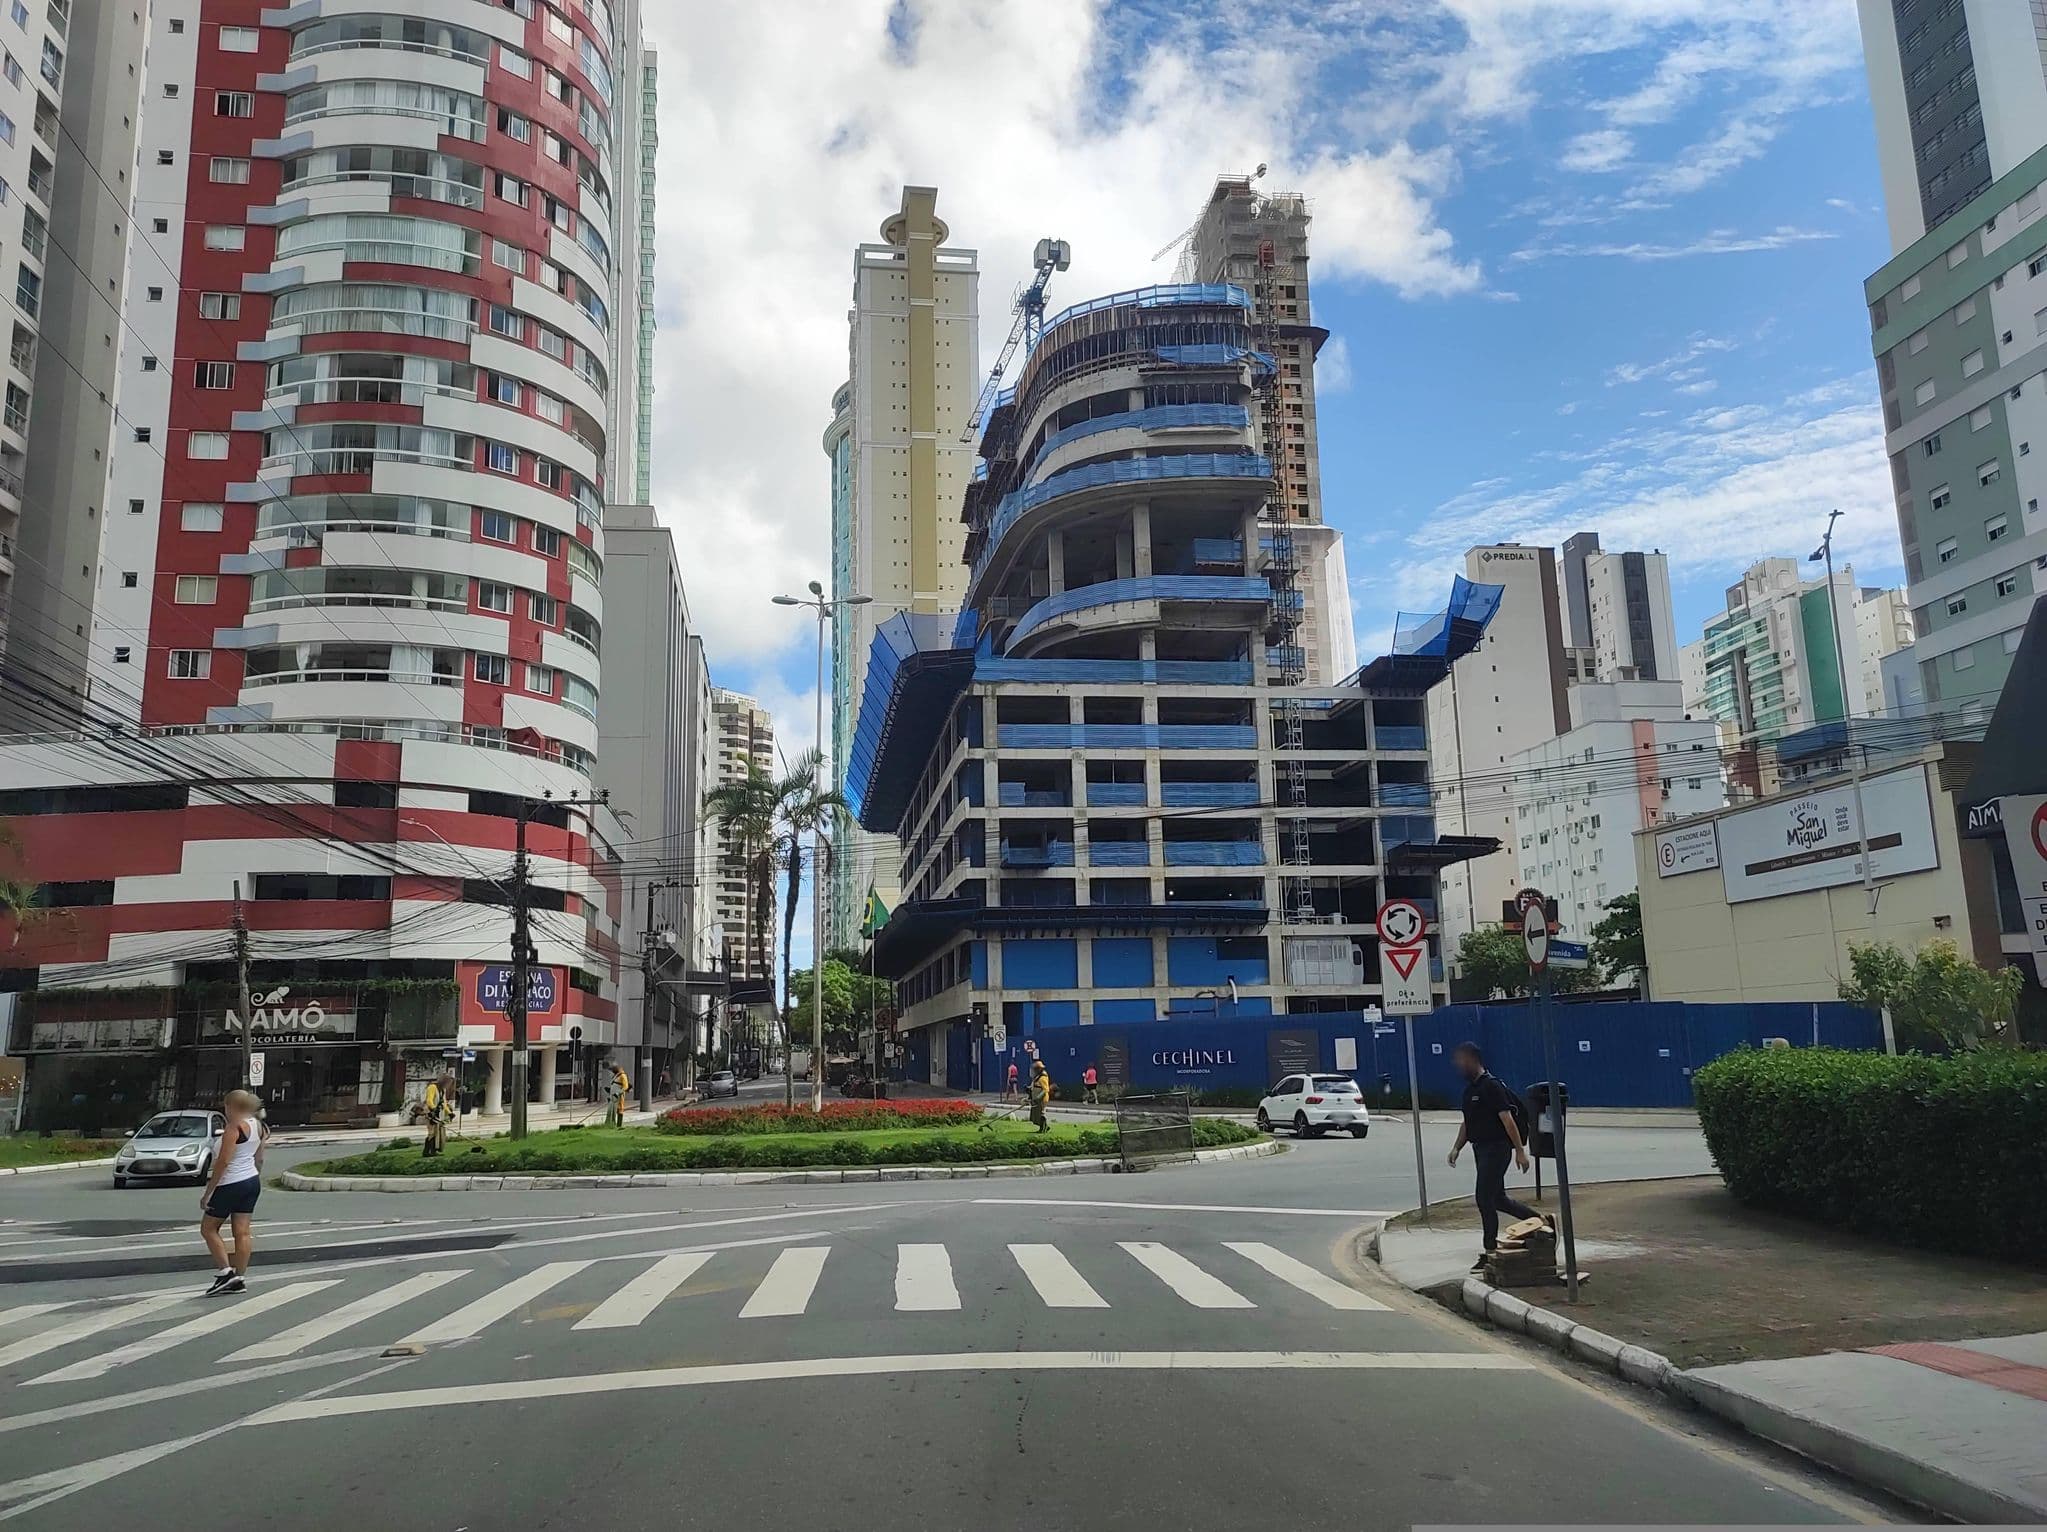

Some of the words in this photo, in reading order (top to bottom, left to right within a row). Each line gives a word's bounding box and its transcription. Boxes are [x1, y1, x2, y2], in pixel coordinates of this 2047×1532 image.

[1789, 802, 1818, 817] PASSEIO
[1797, 812, 1820, 830] San
[1786, 818, 1828, 849] Miguel
[1548, 949, 1571, 957] venida
[499, 970, 543, 984] ESNA
[485, 985, 498, 998] DI
[502, 986, 551, 999] MACO
[1386, 999, 1429, 1007] preferência
[225, 1000, 325, 1030] NAMÔ
[235, 1035, 316, 1044] COCOLATERIA
[1152, 1048, 1236, 1067] CECHINEL
